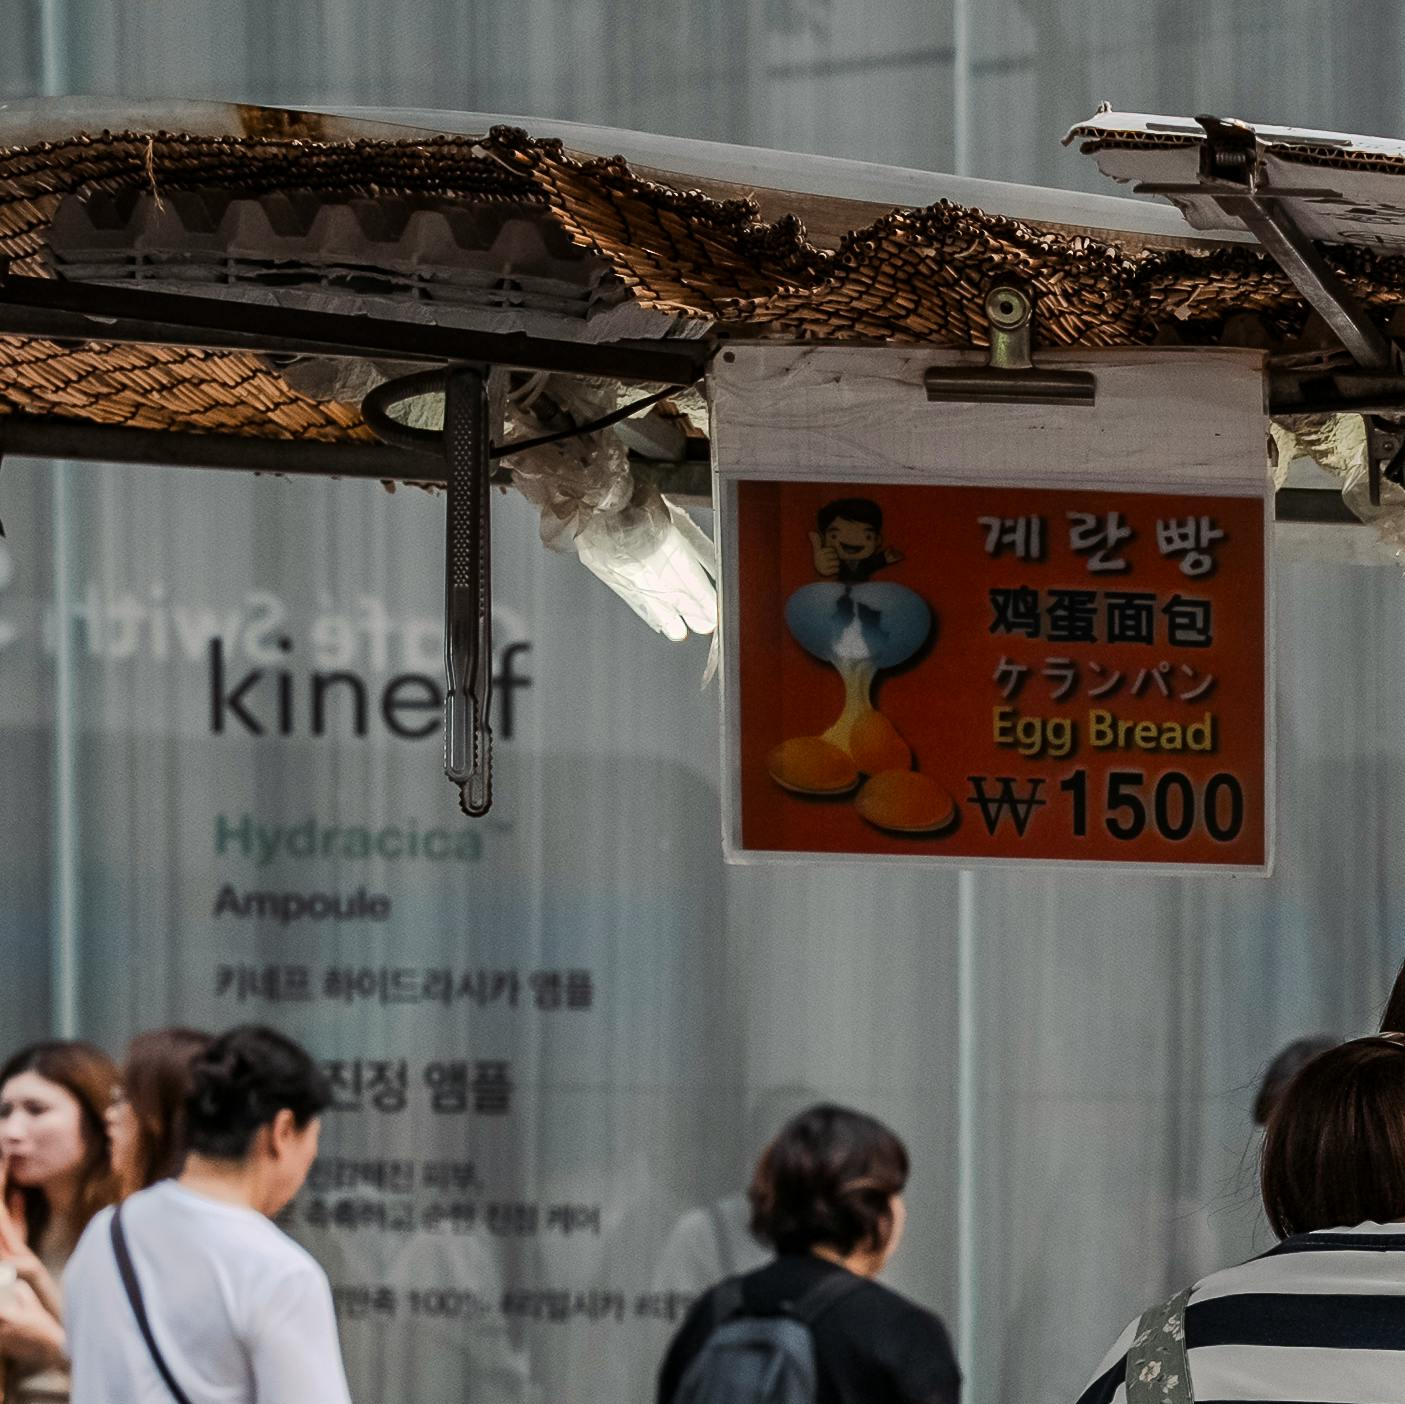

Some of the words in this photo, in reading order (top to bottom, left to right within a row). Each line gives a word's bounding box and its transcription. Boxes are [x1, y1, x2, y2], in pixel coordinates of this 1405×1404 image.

[987, 586, 1213, 649] 鸡蛋面包
[992, 656, 1215, 701] ケランパン
[992, 706, 1073, 757] Egg
[1089, 708, 1213, 751] Bread
[212, 883, 392, 924] Ampoule
